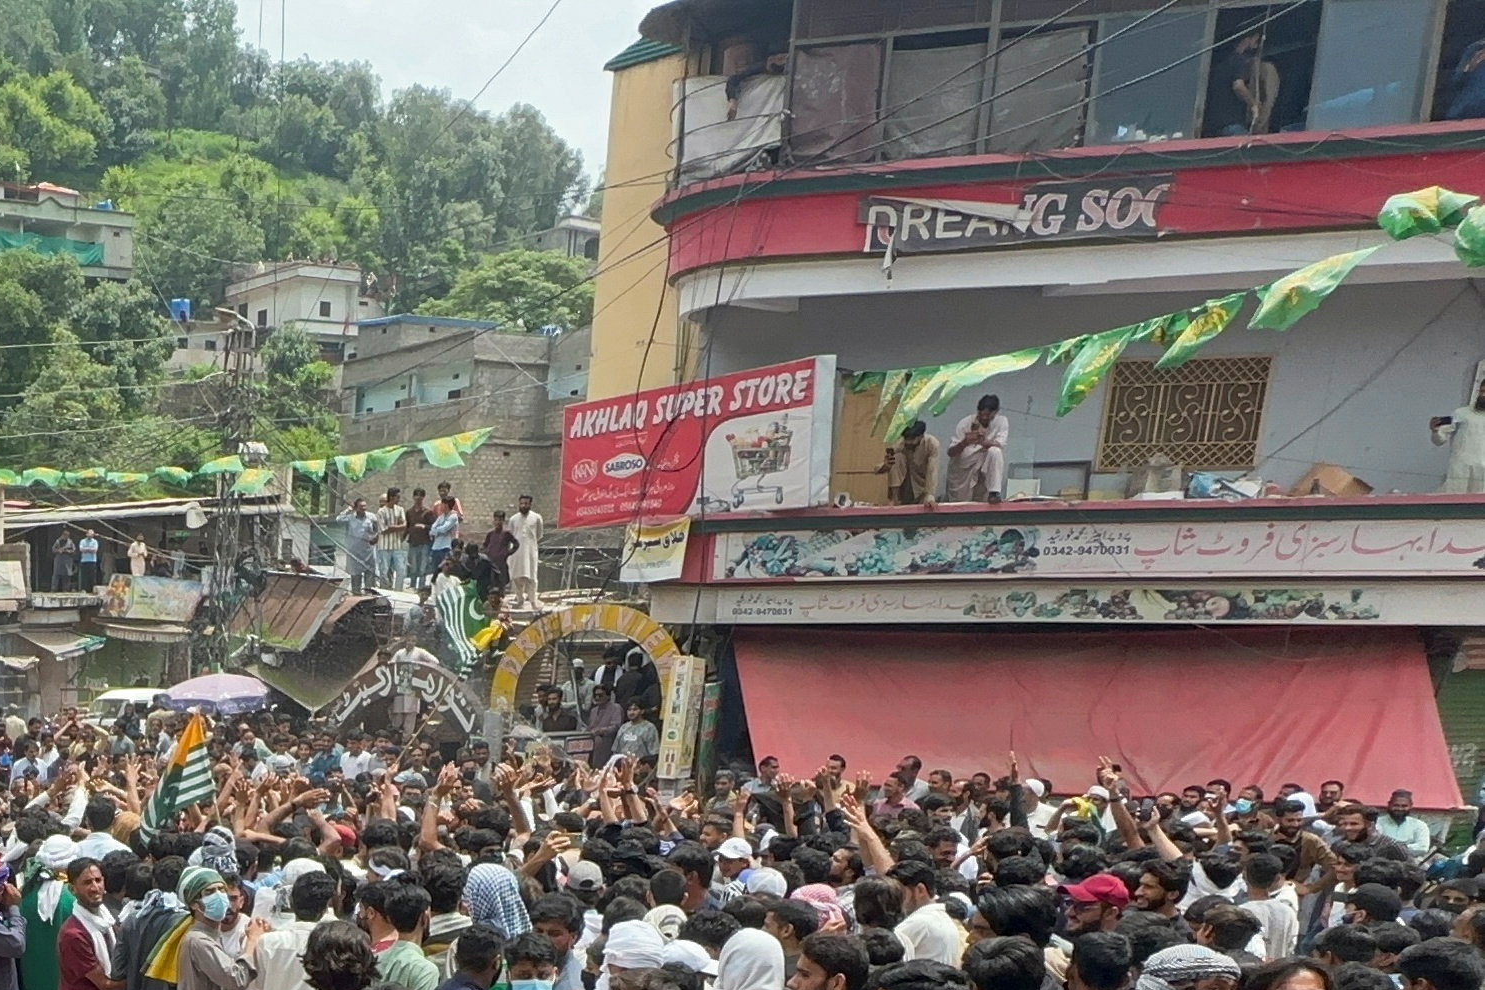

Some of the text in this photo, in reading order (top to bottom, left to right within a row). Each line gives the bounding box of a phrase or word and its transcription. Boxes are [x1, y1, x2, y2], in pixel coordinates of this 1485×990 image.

[569, 369, 813, 439] AKHLAQ SUPER STORE
[604, 458, 644, 474] SABROSO
[1043, 545, 1130, 556] 0342-9470031
[1133, 526, 1197, 570] شاپ
[1196, 522, 1276, 565] فروٹ
